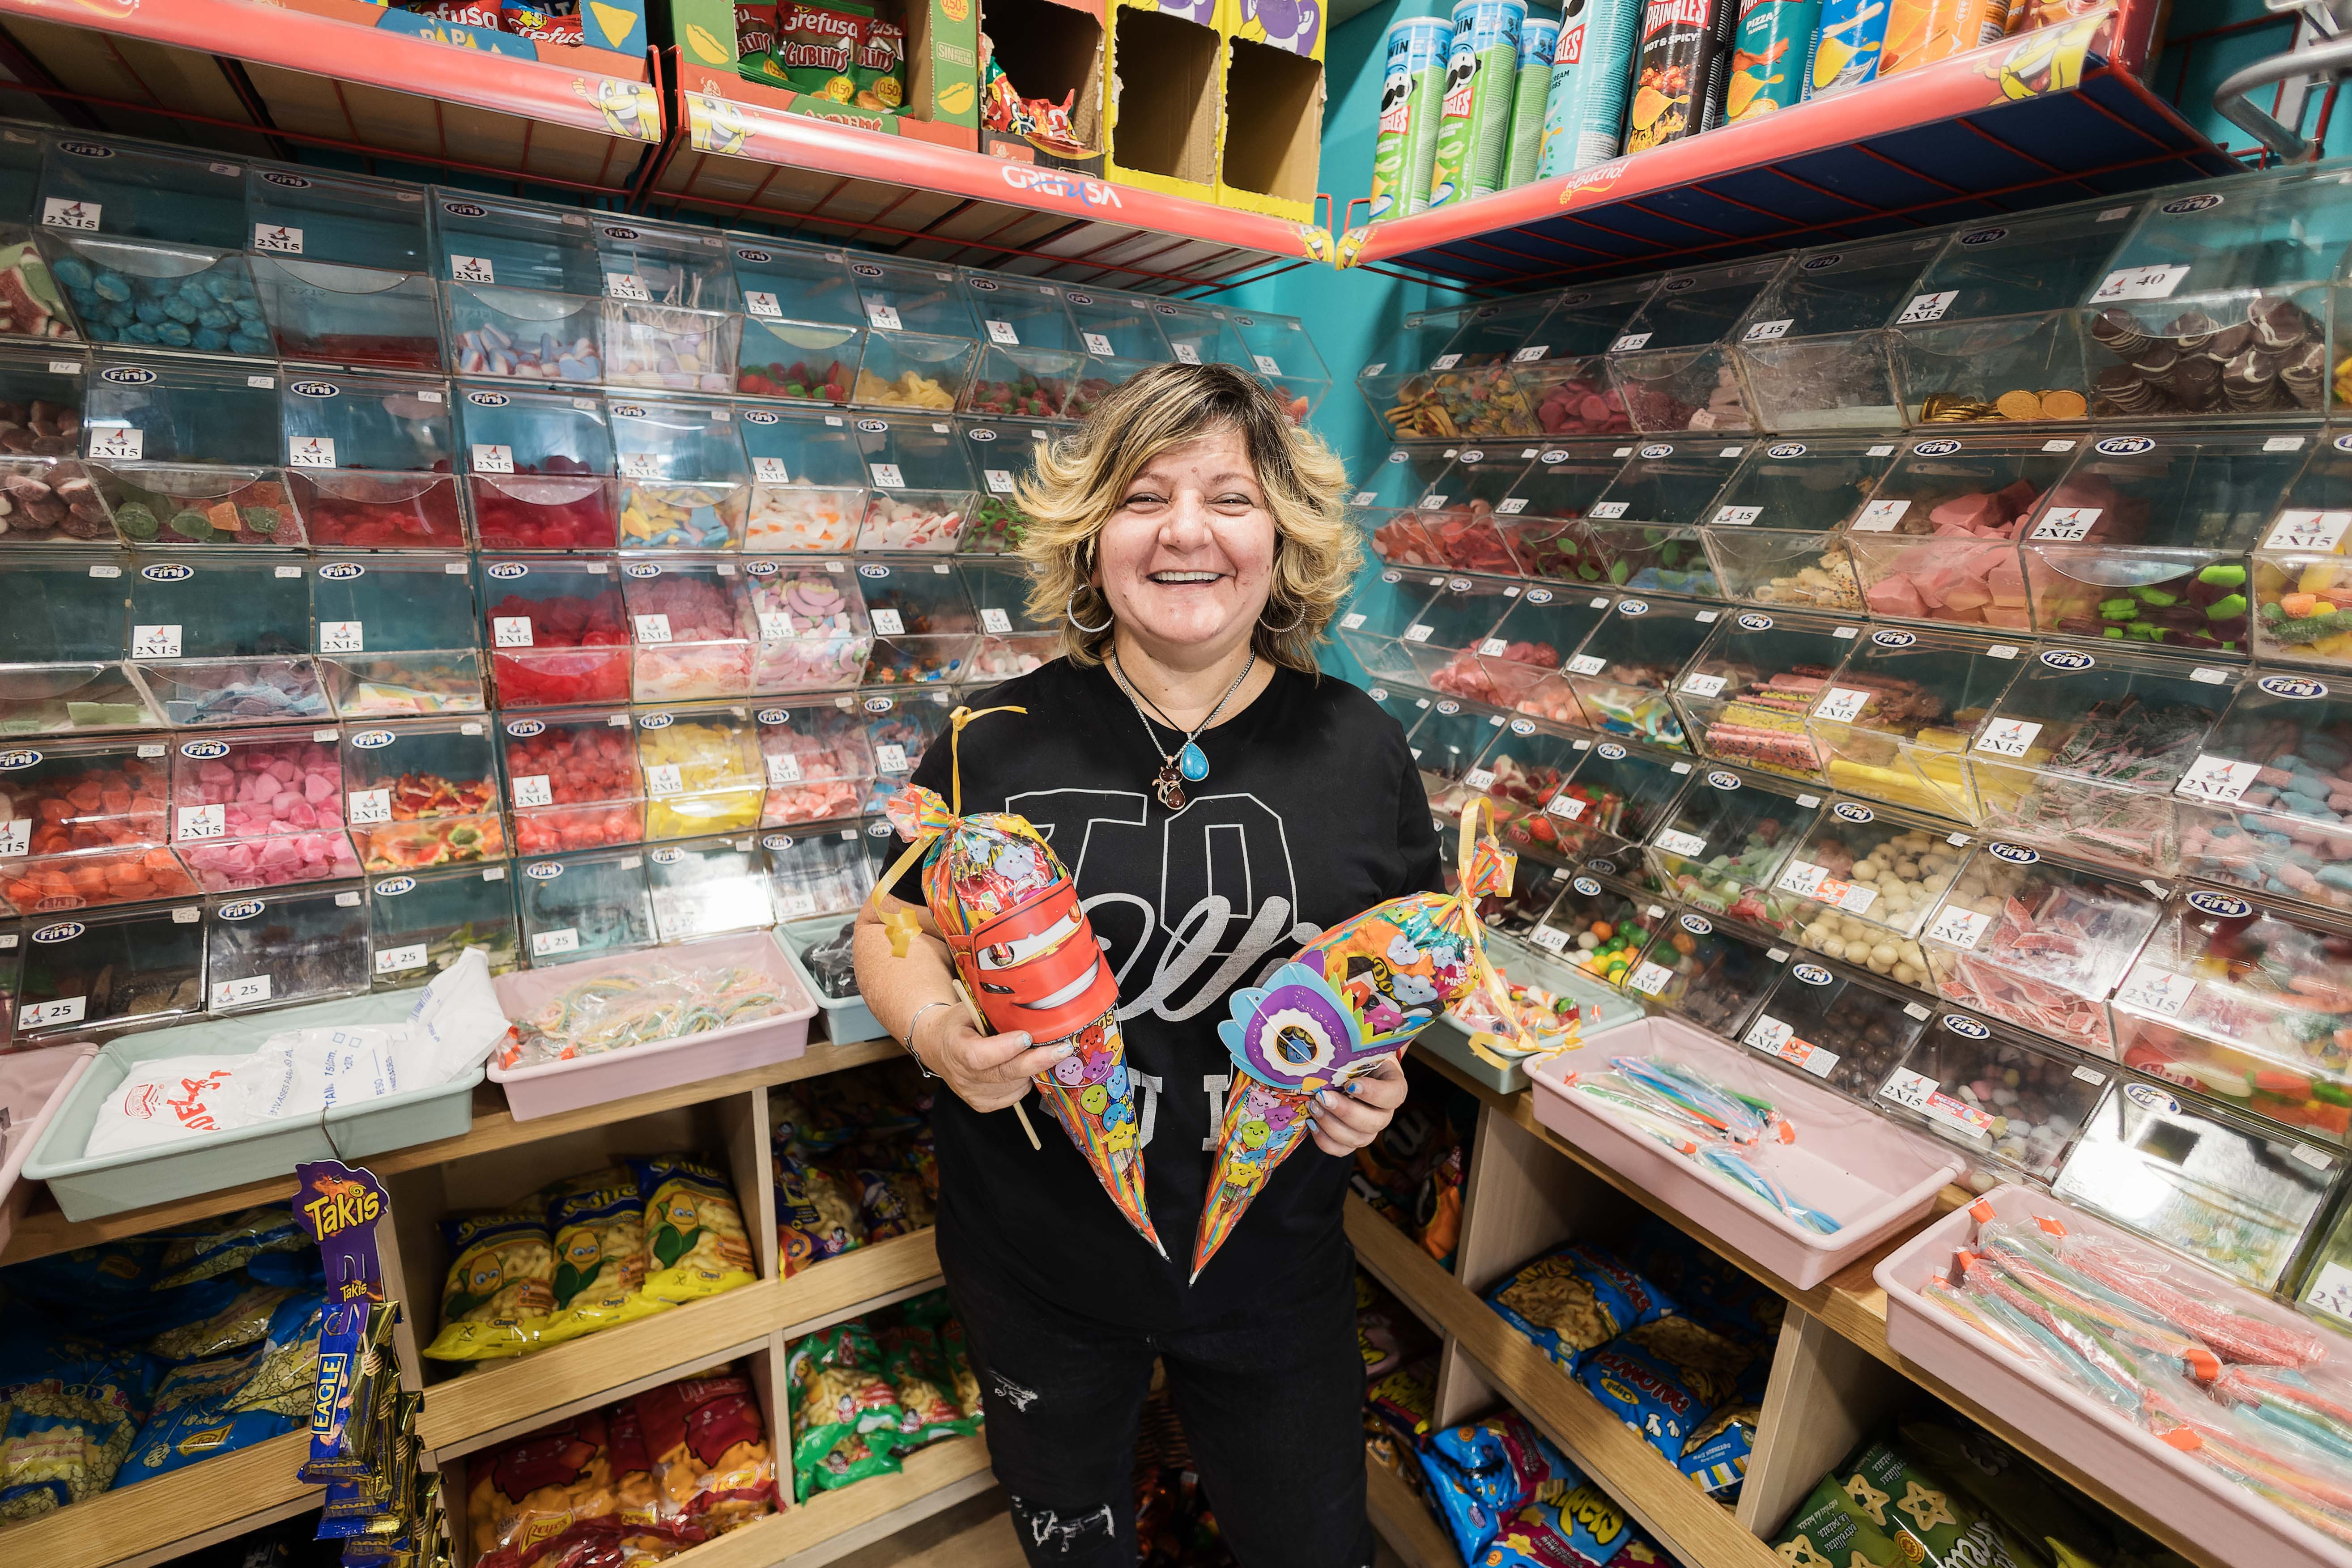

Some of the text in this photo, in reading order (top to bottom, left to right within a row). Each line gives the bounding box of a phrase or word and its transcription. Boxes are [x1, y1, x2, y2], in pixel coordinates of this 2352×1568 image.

[1644, 0, 1707, 39] PRINGLES
[1746, 13, 1773, 30] PIZZA
[1644, 32, 1700, 53] HOT & SPICY
[938, 44, 953, 60] SIN
[270, 175, 305, 186] Fini
[1002, 166, 1123, 208] GREFUSA
[452, 204, 480, 215] Fini
[2168, 200, 2211, 211] Fini
[47, 217, 95, 228] 2X15
[608, 228, 634, 238] Fini
[258, 239, 299, 251] 2X15
[742, 251, 766, 260] Fini
[455, 271, 491, 281] 2X15
[2136, 273, 2165, 285] 40
[613, 287, 644, 297] 2X15
[751, 305, 780, 314] 2X15
[1901, 309, 1943, 322] 2X15
[872, 317, 899, 327] 2X15
[990, 331, 1015, 342] 2X15
[110, 371, 147, 381] Fini
[299, 385, 333, 395] Fini
[474, 394, 505, 405] Fini
[749, 413, 774, 422] Fini
[862, 421, 884, 430] Fini
[1772, 446, 1803, 456] Fini
[1918, 442, 1956, 455] Fini
[2102, 439, 2144, 452] Fini
[93, 447, 138, 457] 2X15
[293, 455, 332, 464] 2X15
[476, 461, 511, 471] 2X15
[629, 467, 658, 476] 2X15
[759, 470, 785, 480] 2X15
[876, 476, 901, 486] 2X15
[2035, 527, 2083, 539] 2X15
[2270, 535, 2331, 547] 2X15
[150, 567, 184, 578] Fini
[327, 566, 358, 576] Fini
[495, 565, 523, 576] Fini
[632, 565, 656, 575] Fini
[751, 564, 774, 572] Fini
[863, 567, 886, 575] Fini
[876, 622, 902, 632] 2X15
[987, 621, 1009, 630] 2X15
[1744, 616, 1768, 628] Fini
[639, 631, 669, 640] 2X15
[765, 627, 793, 637] 2X15
[498, 634, 529, 643] 2X15
[1877, 633, 1908, 645] Fini
[135, 645, 178, 655] 2X15
[323, 640, 360, 649] 2X15
[2046, 654, 2088, 667] Fini
[2266, 680, 2318, 696] Fini
[868, 700, 889, 709] Fini
[763, 712, 785, 721] Fini
[1820, 706, 1855, 719] 2X15
[644, 716, 668, 727] Fini
[512, 722, 540, 734] Fini
[359, 733, 387, 745] Fini
[188, 744, 223, 756] Fini
[1603, 746, 1623, 757] Fini
[1982, 738, 2025, 754] 2X15
[881, 760, 906, 769] 2X15
[772, 770, 798, 780] 2X15
[652, 782, 681, 792] 2X15
[2183, 778, 2239, 798] 2X15
[519, 794, 549, 805] 2X15
[353, 809, 386, 820] 2X15
[1839, 806, 1869, 820] Fini
[180, 825, 221, 837] 2X15
[657, 851, 680, 862] Fini
[1995, 846, 2034, 861] Fini
[532, 864, 559, 874] Fini
[380, 879, 411, 892] Fini
[1781, 875, 1813, 893] 2X15
[2196, 894, 2242, 913] Fini
[225, 904, 258, 917] Fini
[39, 926, 76, 939] Fini
[1933, 926, 1973, 944] 2X15
[555, 936, 568, 945] 25
[400, 952, 416, 962] 25
[1799, 966, 1828, 982] Fini
[241, 984, 258, 995] 25
[1632, 977, 1659, 992] 2X15
[2125, 988, 2179, 1011] 2X15
[51, 1005, 72, 1017] 25
[1949, 1019, 1986, 1036] Fini
[1749, 1033, 1780, 1051] 2X15
[1884, 1085, 1923, 1106] 2X15
[304, 1184, 379, 1242] Takis
[340, 1280, 367, 1302] Takis
[314, 1360, 341, 1428] EAGLE
